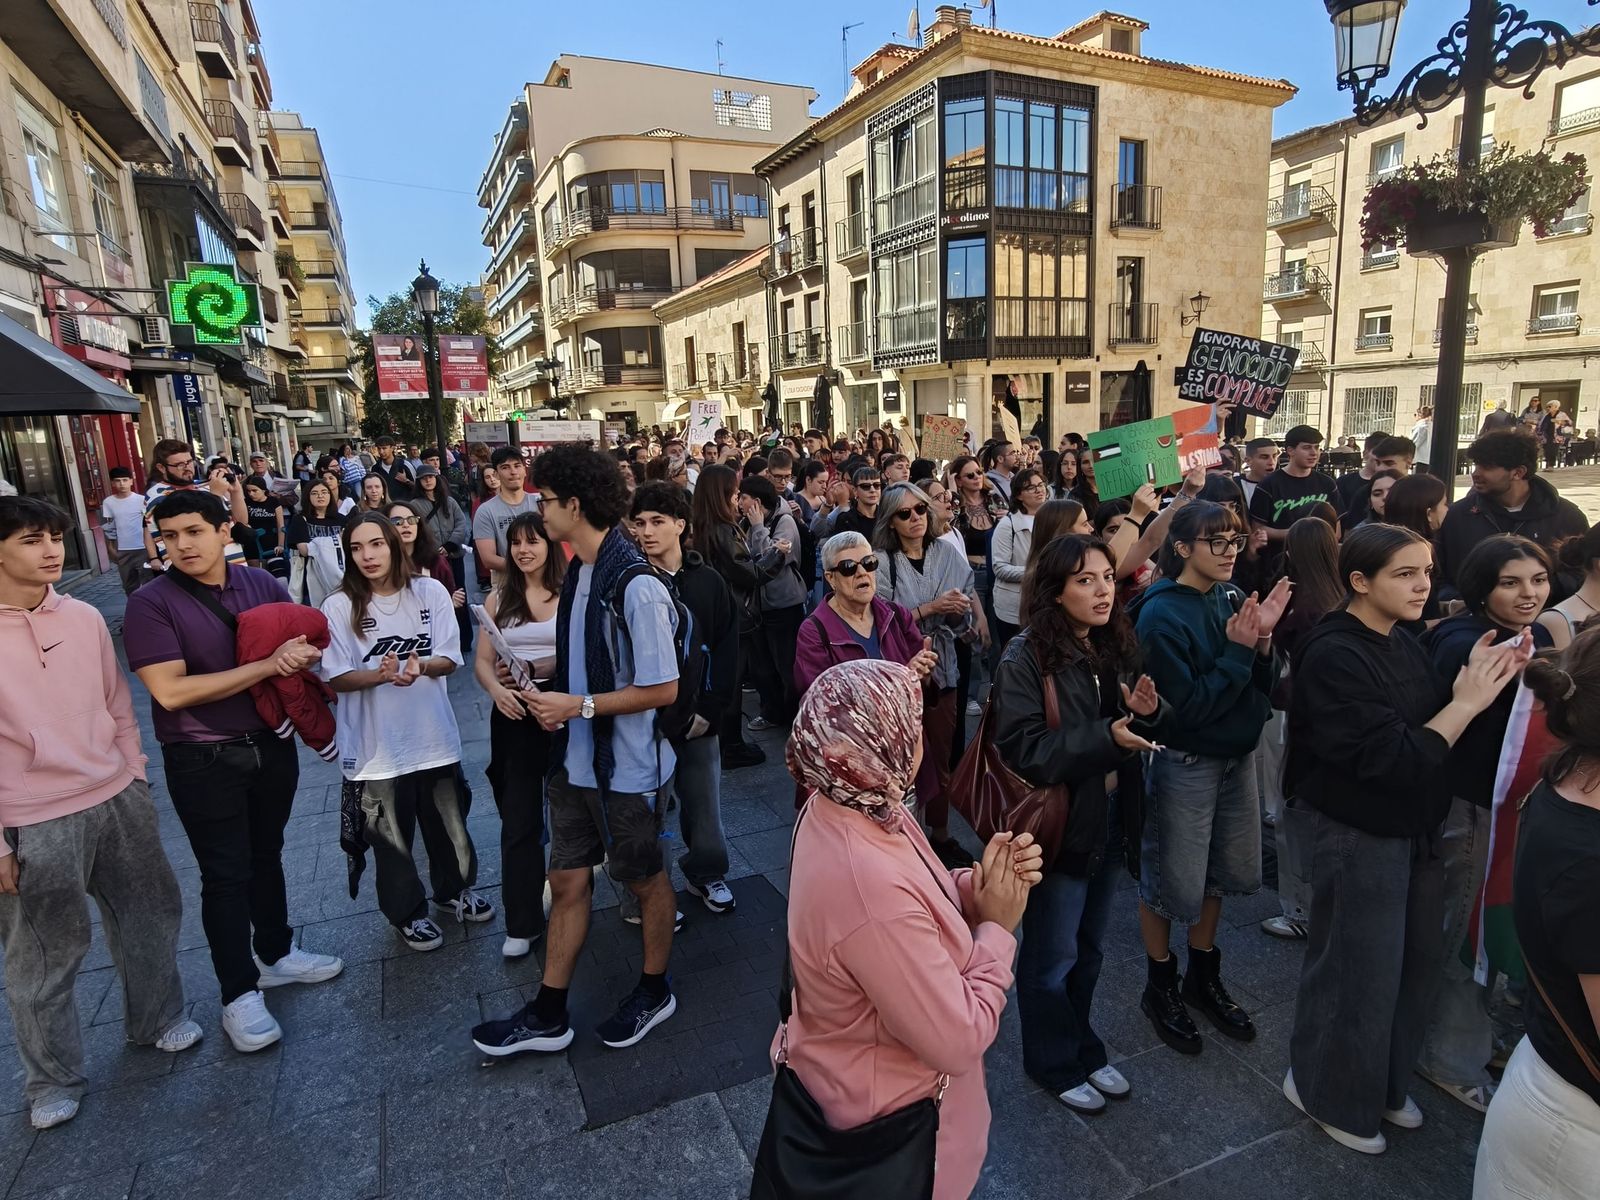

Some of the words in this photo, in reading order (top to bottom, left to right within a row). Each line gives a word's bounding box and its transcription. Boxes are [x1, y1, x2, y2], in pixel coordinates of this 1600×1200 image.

[1199, 331, 1261, 353] IGNORAR
[1269, 345, 1288, 362] EL
[1191, 344, 1293, 387] GENOCIDIO
[1187, 368, 1206, 382] ES
[1180, 382, 1205, 400] SER
[698, 402, 718, 415] FREE
